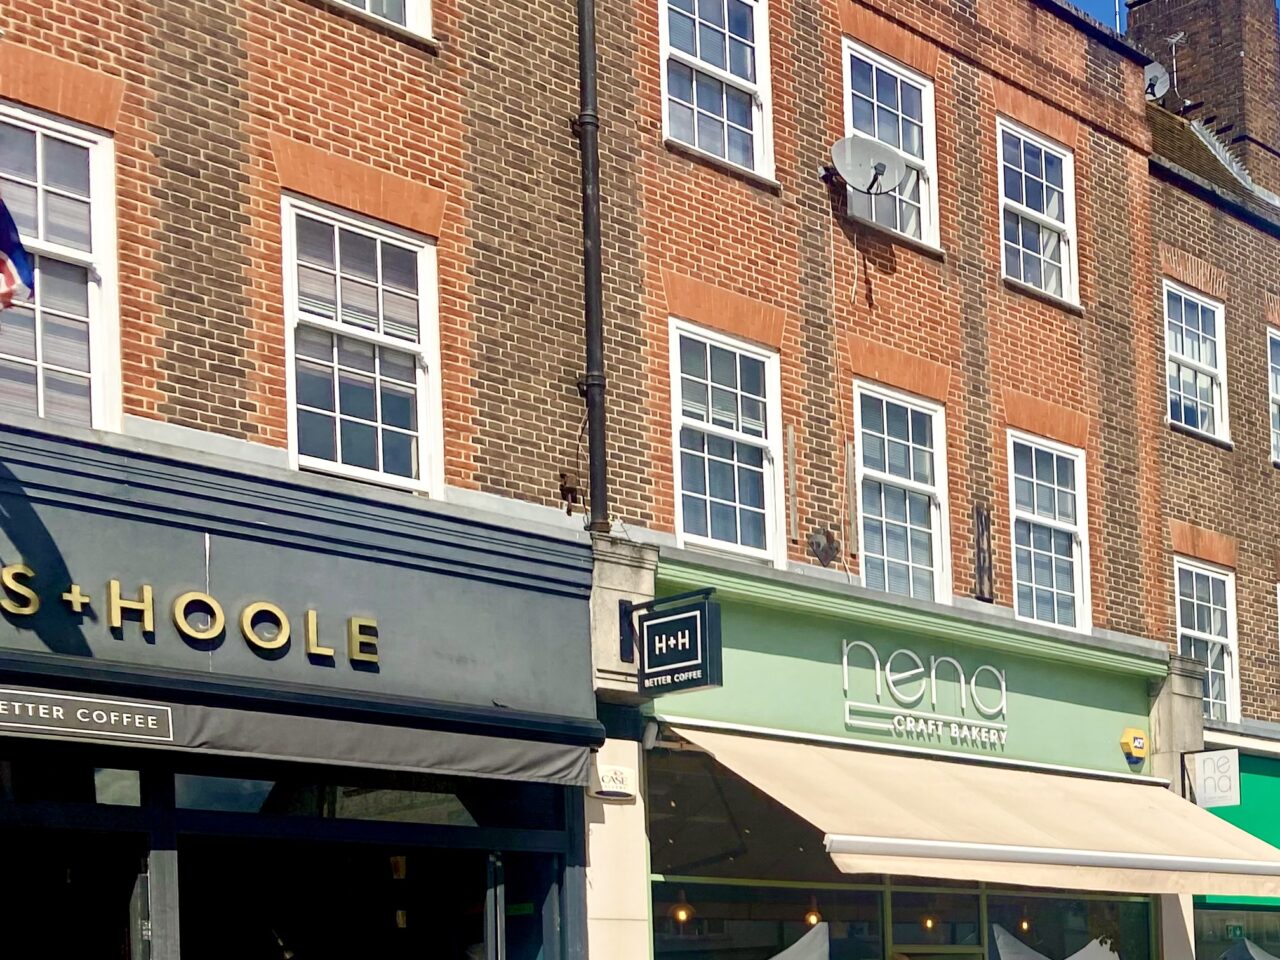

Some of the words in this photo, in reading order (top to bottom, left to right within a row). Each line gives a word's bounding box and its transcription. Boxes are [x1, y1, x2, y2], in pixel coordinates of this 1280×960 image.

[654, 629, 690, 655] H+H
[644, 673, 672, 688] BETTER
[674, 669, 702, 683] COFFEE
[841, 637, 1008, 717] nena
[76, 708, 158, 729] COFFEE
[893, 715, 943, 736] CRAFT
[950, 721, 1008, 745] BAKERY
